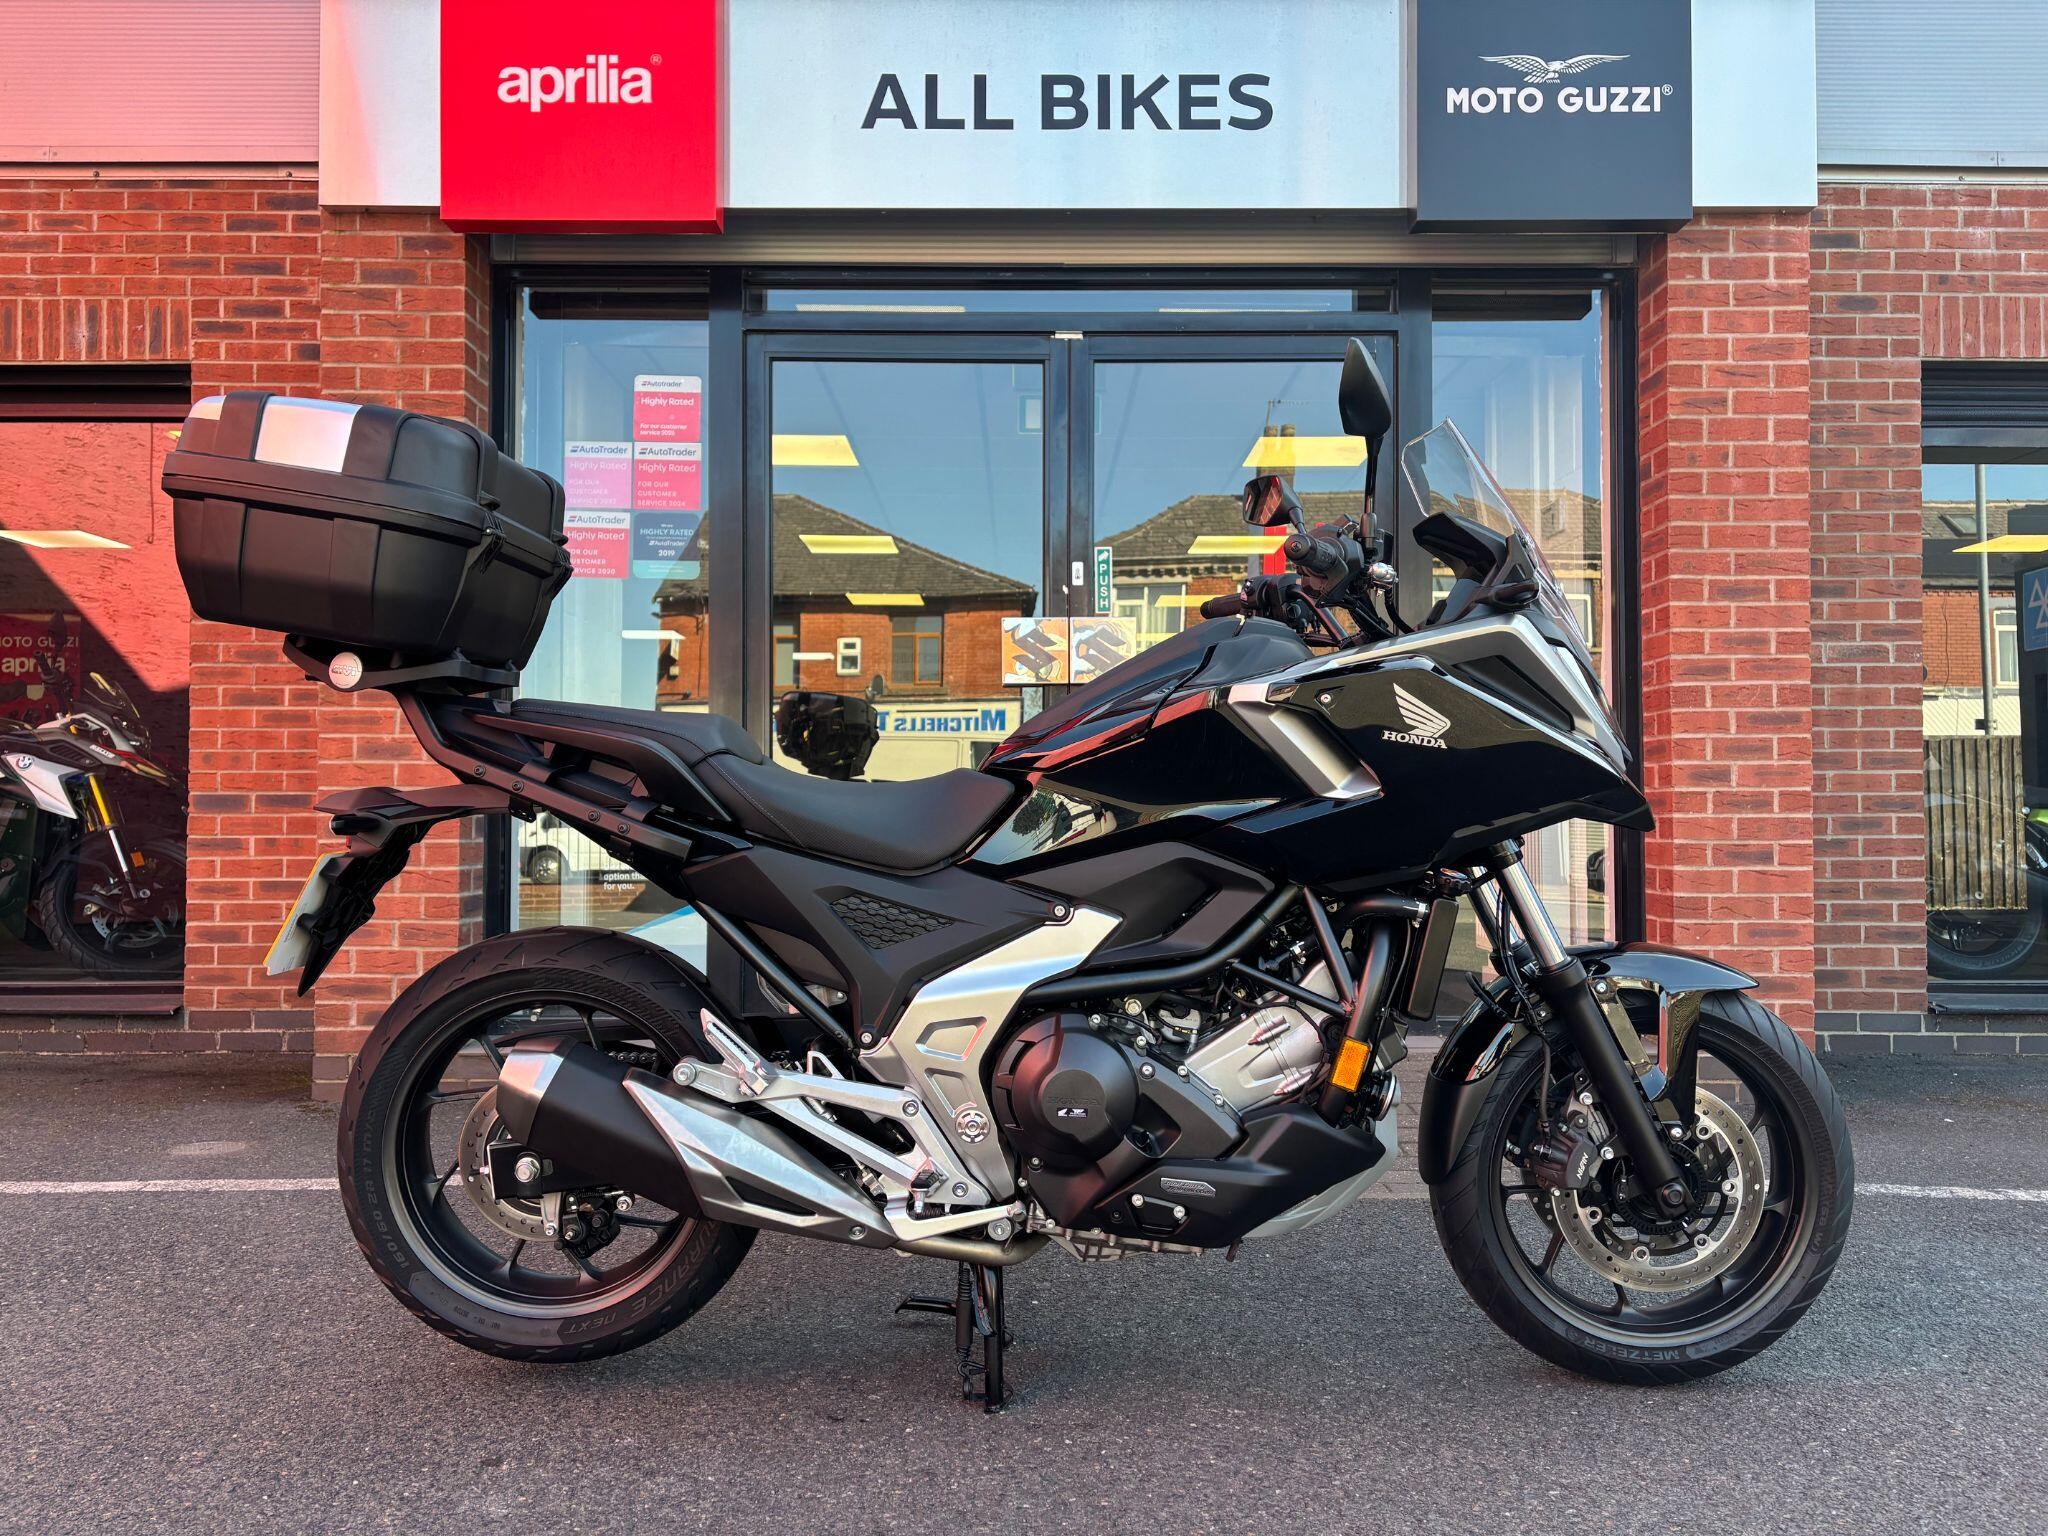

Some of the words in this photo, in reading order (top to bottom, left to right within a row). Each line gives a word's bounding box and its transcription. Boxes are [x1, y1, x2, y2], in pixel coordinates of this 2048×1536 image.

[497, 54, 653, 113] aprilia
[861, 73, 1014, 130] ALL
[1041, 73, 1274, 130] BIKES
[1446, 87, 1544, 114] MOTO
[640, 396, 668, 407] Highly
[668, 397, 695, 406] Rated
[579, 445, 628, 454] AutoTrader
[648, 448, 697, 456] AutoTrader
[570, 461, 599, 471] Highly
[600, 462, 627, 470] Rated
[638, 463, 667, 473] Highly
[668, 464, 696, 472] Rated
[576, 515, 626, 524] AutoTrader
[567, 531, 596, 541] Highly
[597, 532, 625, 541] Rated
[658, 549, 676, 557] 2019
[1099, 563, 1109, 609] PUSH
[0, 636, 33, 648] OTO
[1382, 730, 1448, 749] HONDA
[603, 872, 630, 882] option
[603, 882, 615, 890] for
